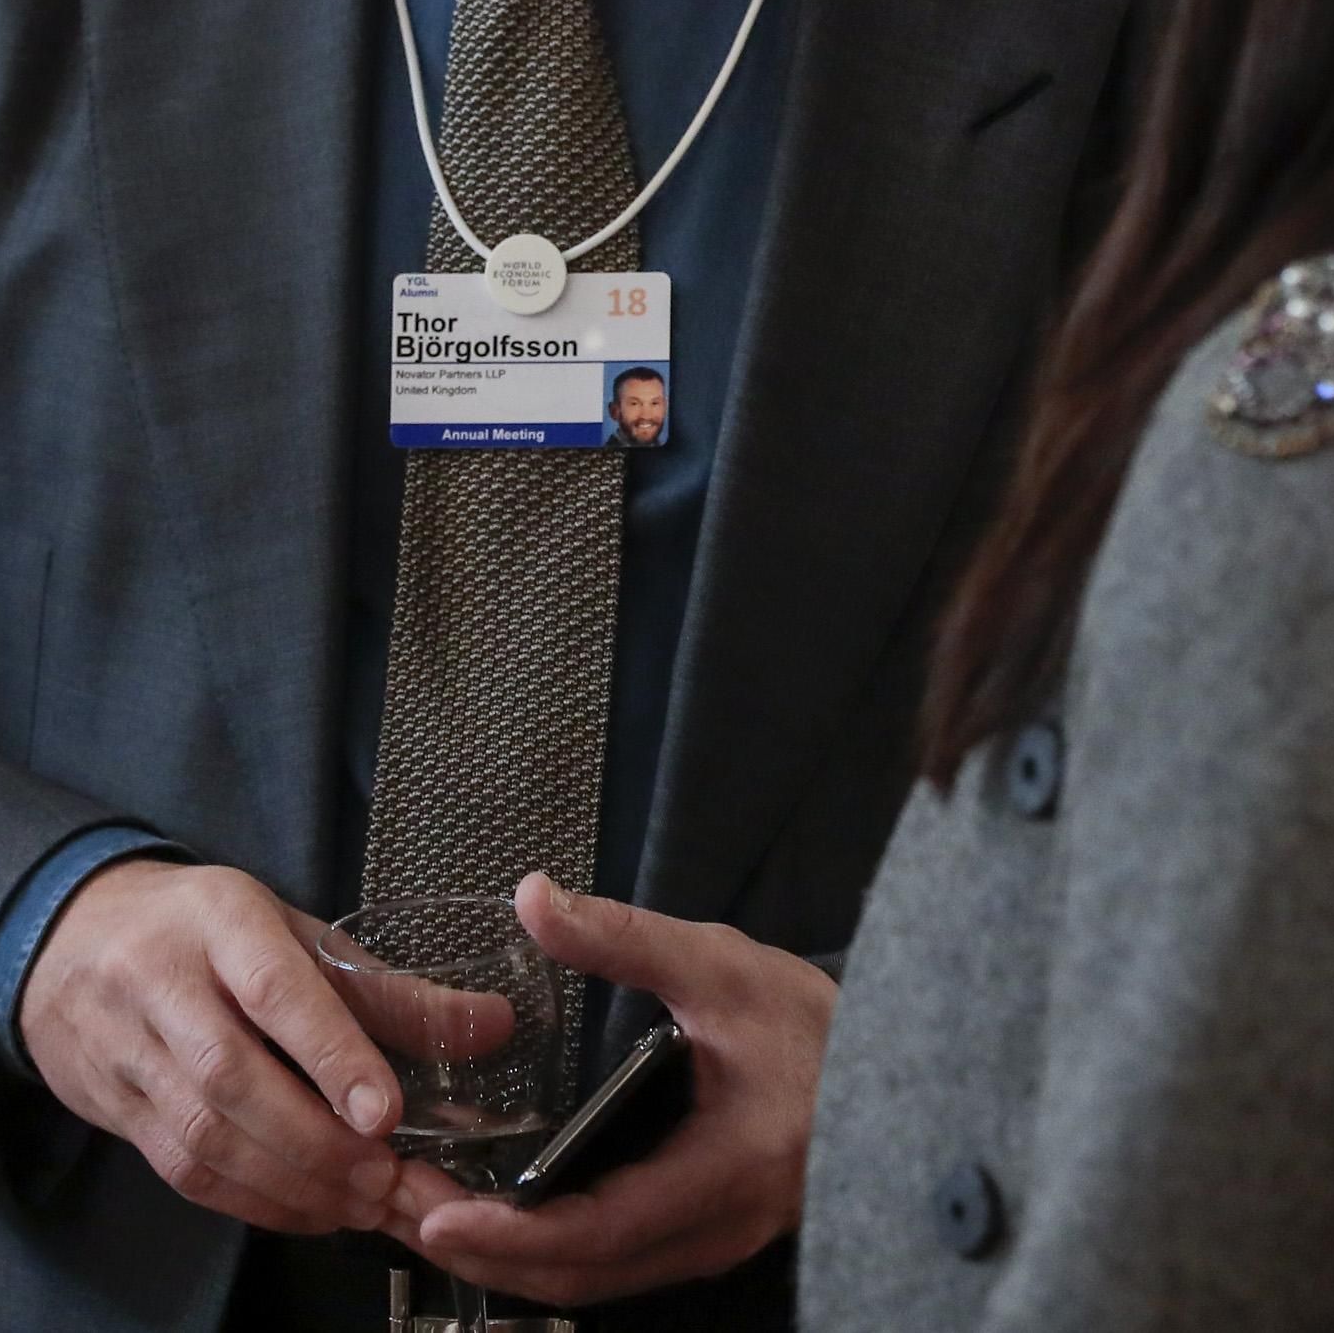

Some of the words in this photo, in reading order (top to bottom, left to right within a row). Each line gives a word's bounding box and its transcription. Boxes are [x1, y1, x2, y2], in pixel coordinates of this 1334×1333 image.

[502, 261, 542, 270] WORLD
[493, 270, 552, 279] ECONOMIC
[406, 276, 430, 286] YGL
[502, 279, 541, 287] FORUM
[399, 288, 439, 298] Alumni
[607, 286, 648, 316] 18
[396, 312, 459, 333] Thor
[396, 335, 578, 363] Björgolfsson
[396, 369, 436, 379] Novator
[439, 369, 483, 379] Partners
[485, 369, 507, 379] LLP
[395, 385, 429, 395] United
[432, 385, 478, 397] Kingdom
[441, 428, 489, 440] Annual
[491, 428, 545, 443] Meeting
